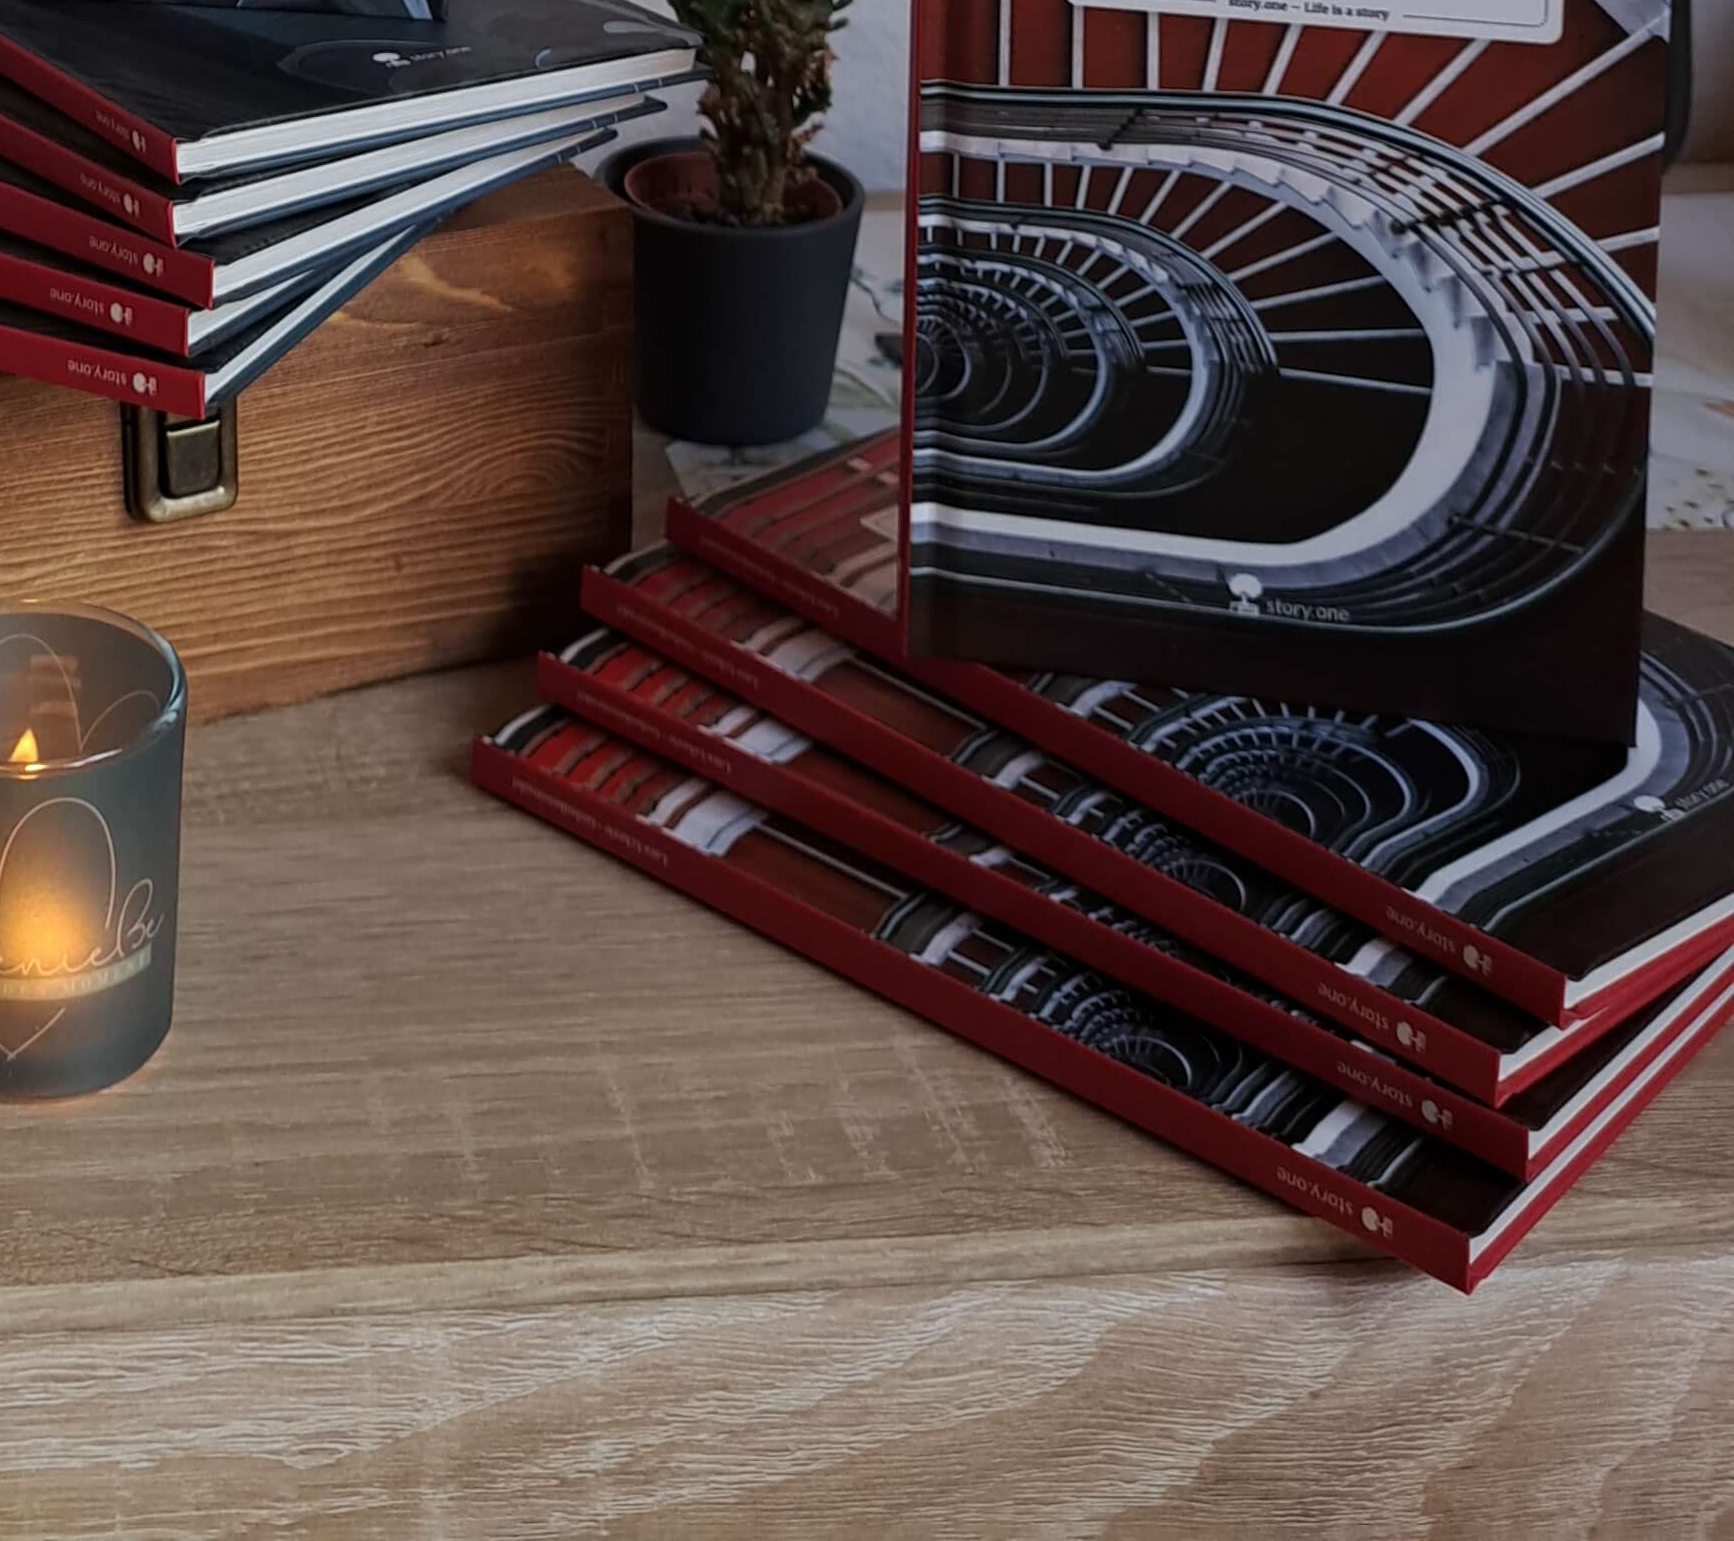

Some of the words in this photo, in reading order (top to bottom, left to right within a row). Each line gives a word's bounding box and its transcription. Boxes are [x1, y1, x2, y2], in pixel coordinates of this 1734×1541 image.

[1304, 1, 1329, 17] Life
[1332, 3, 1343, 17] is
[1345, 7, 1354, 18] a
[1356, 6, 1390, 22] story
[89, 235, 139, 267] story.one
[50, 287, 105, 313] story.one
[67, 359, 127, 386] story.one
[1266, 598, 1351, 623] story.one
[1385, 904, 1456, 953] story.one
[1318, 981, 1389, 1032] story.one
[1337, 1060, 1413, 1114] story.one
[1276, 1164, 1354, 1216] story.one
